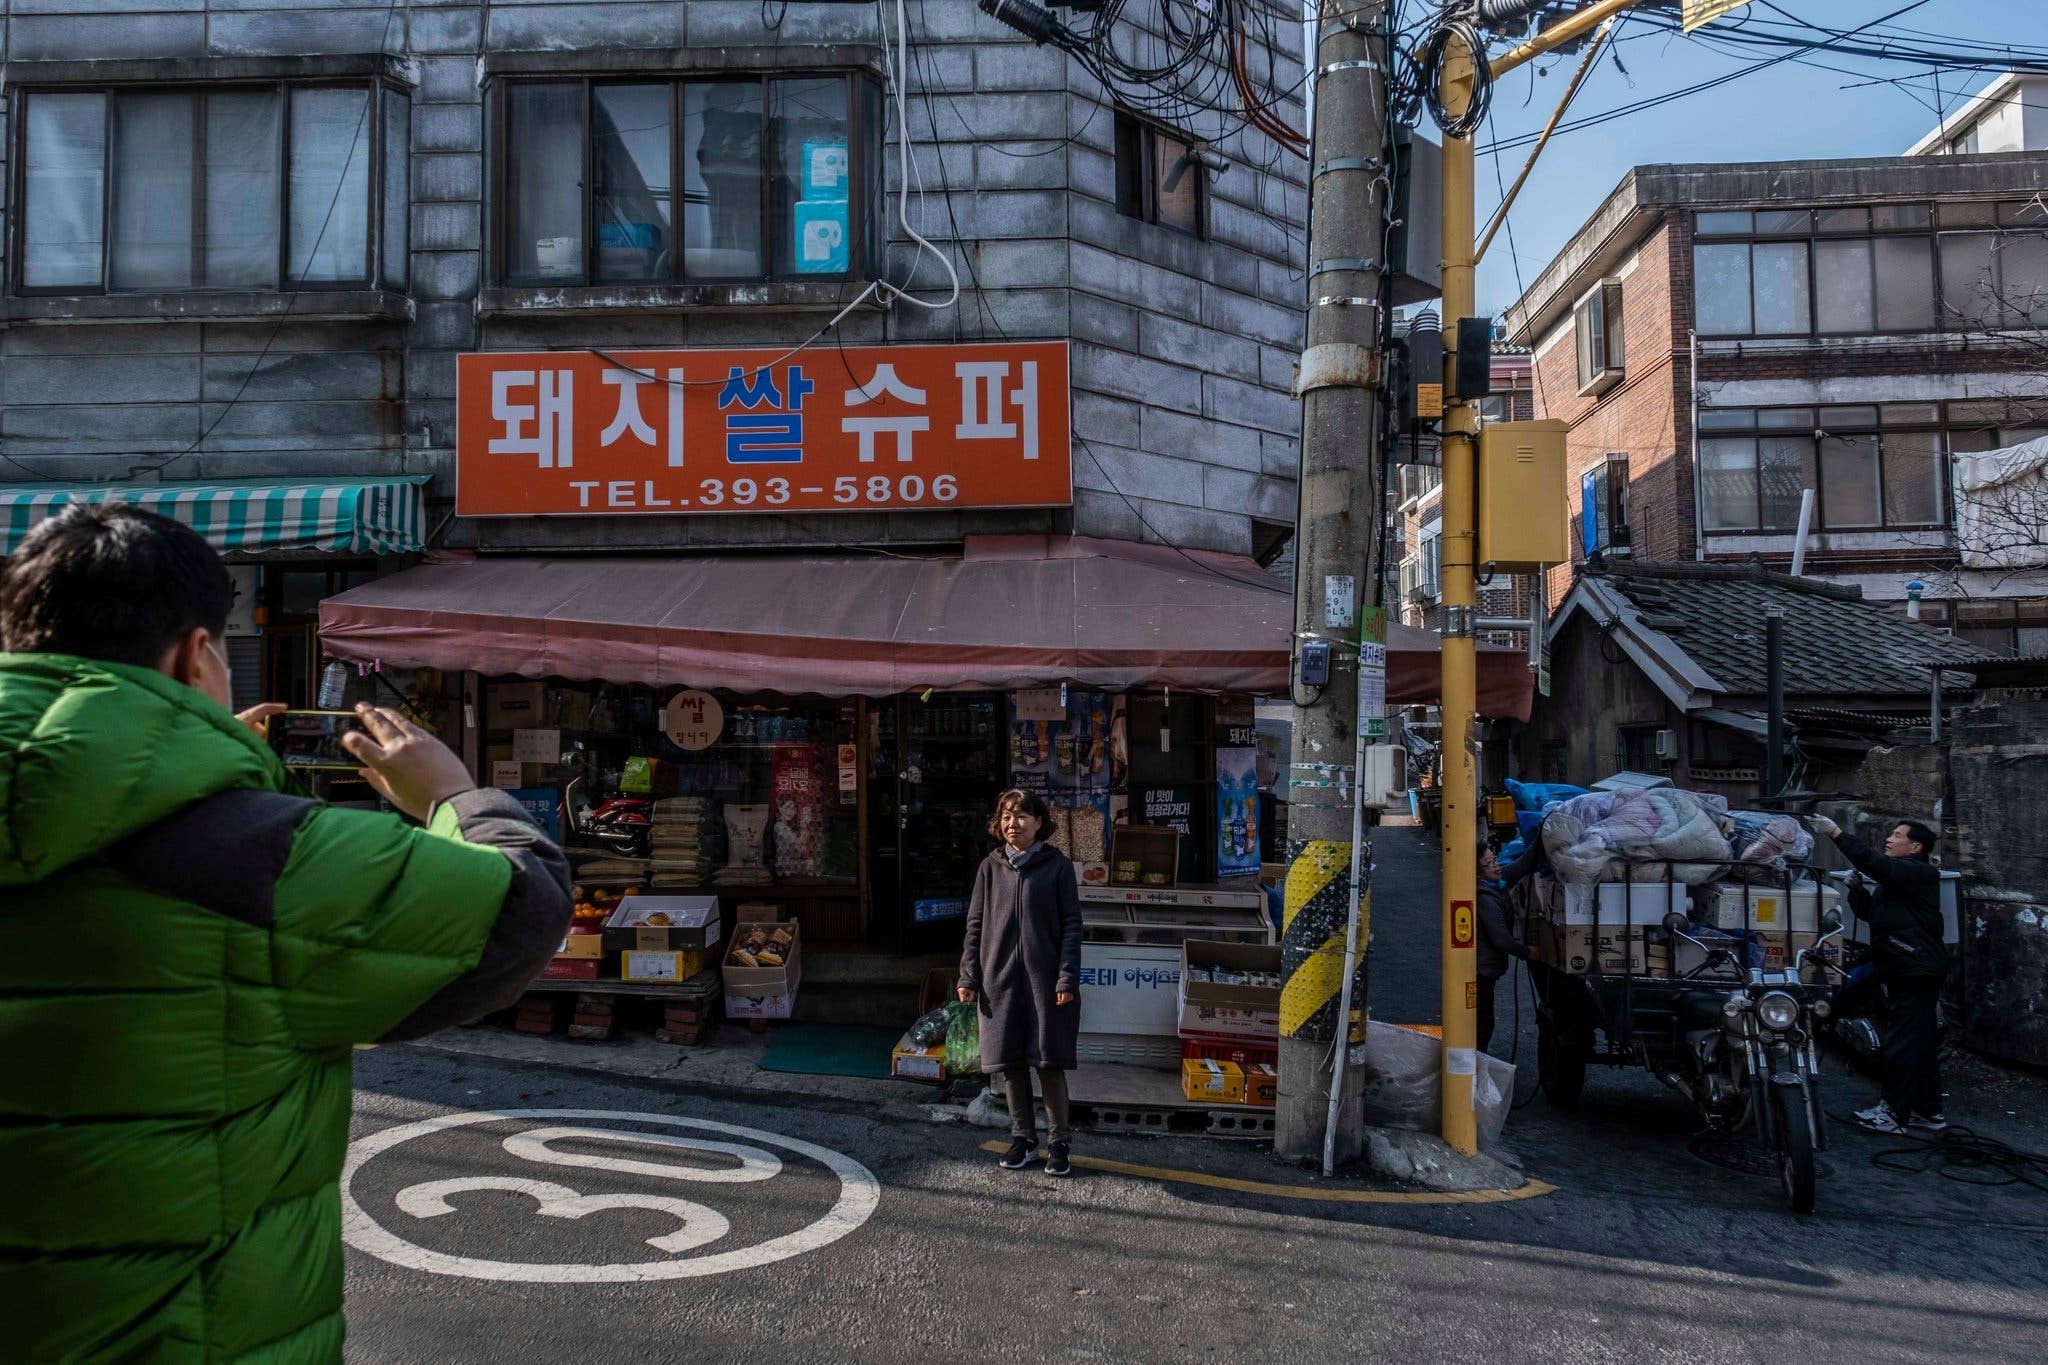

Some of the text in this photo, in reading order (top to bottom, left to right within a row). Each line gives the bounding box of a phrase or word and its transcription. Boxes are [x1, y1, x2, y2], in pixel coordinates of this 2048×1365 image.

[568, 474, 960, 508] TEL.393-5806
[680, 697, 705, 724] 쌀
[1145, 788, 1174, 804] 이 맛이
[394, 1126, 783, 1254] 30
